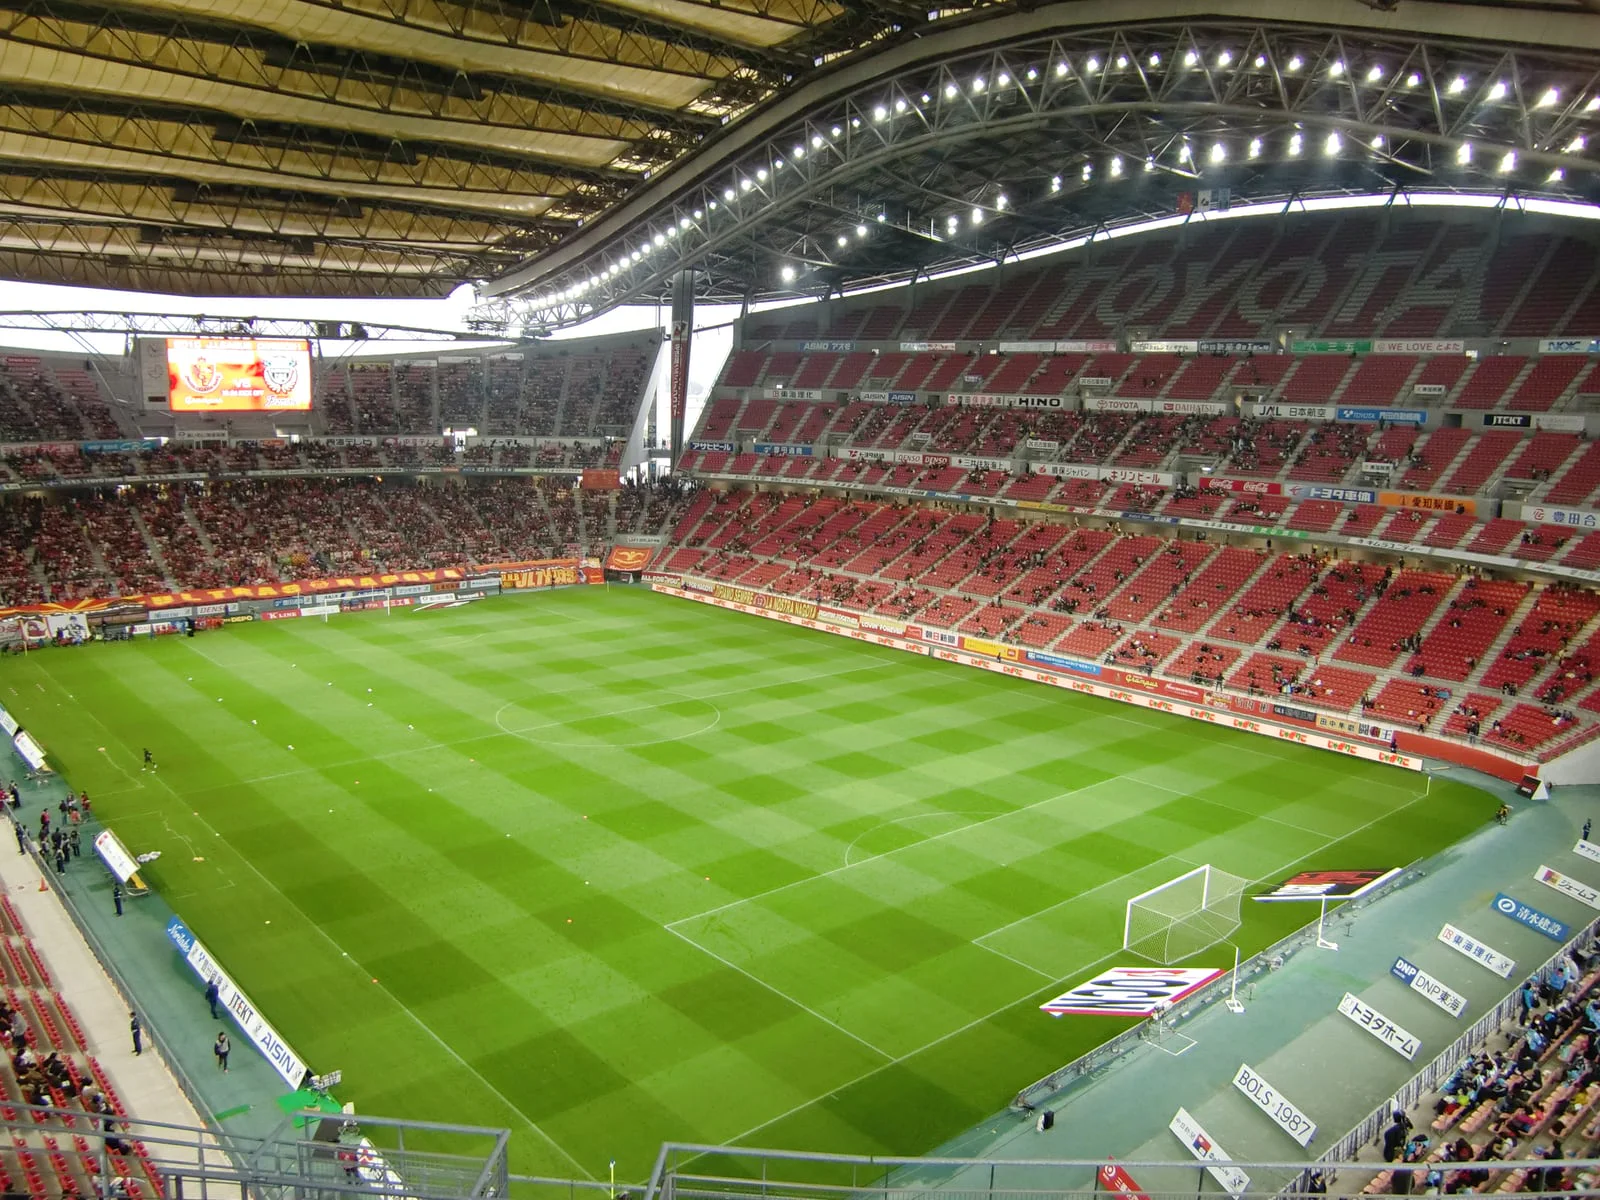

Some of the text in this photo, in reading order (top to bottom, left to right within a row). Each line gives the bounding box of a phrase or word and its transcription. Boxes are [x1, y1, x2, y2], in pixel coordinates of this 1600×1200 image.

[1042, 246, 1488, 326] TOYOTA
[864, 393, 886, 401] AISIN
[891, 394, 914, 402] AISIN
[1019, 397, 1061, 407] HINO
[1109, 402, 1139, 410] TOYOTA
[1175, 403, 1215, 412] DAIHATSU
[1259, 405, 1326, 418] JAL 日本航空
[1492, 415, 1523, 425] JTEKT
[692, 442, 732, 451] アサヒビール
[897, 454, 921, 462] DENSO
[925, 456, 948, 464] DENSO
[1110, 471, 1160, 484] キリンビール
[1310, 487, 1372, 502] トヨタ車体
[151, 569, 463, 606] ULTRAS NAGOYA
[231, 614, 253, 623] DEPO
[1149, 699, 1172, 711] じゃがりこ
[1190, 708, 1215, 721] じゃがりこ
[1233, 718, 1260, 732] じゃがりこ
[1279, 728, 1306, 743] じゃがりこ
[1327, 739, 1357, 754] じゃがりこ
[1378, 751, 1410, 767] じゃがりこ
[1558, 879, 1598, 902] ジェームス
[1516, 906, 1562, 937] 清水建設
[1452, 934, 1496, 965] 東海理化
[1395, 960, 1417, 976] DNP
[1415, 975, 1462, 1011] DNP東海
[228, 991, 254, 1025] JTEKT
[1350, 1002, 1414, 1056] トヨタホーム
[260, 1032, 296, 1074] AISIN
[1238, 1069, 1311, 1136] BOLS 1987
